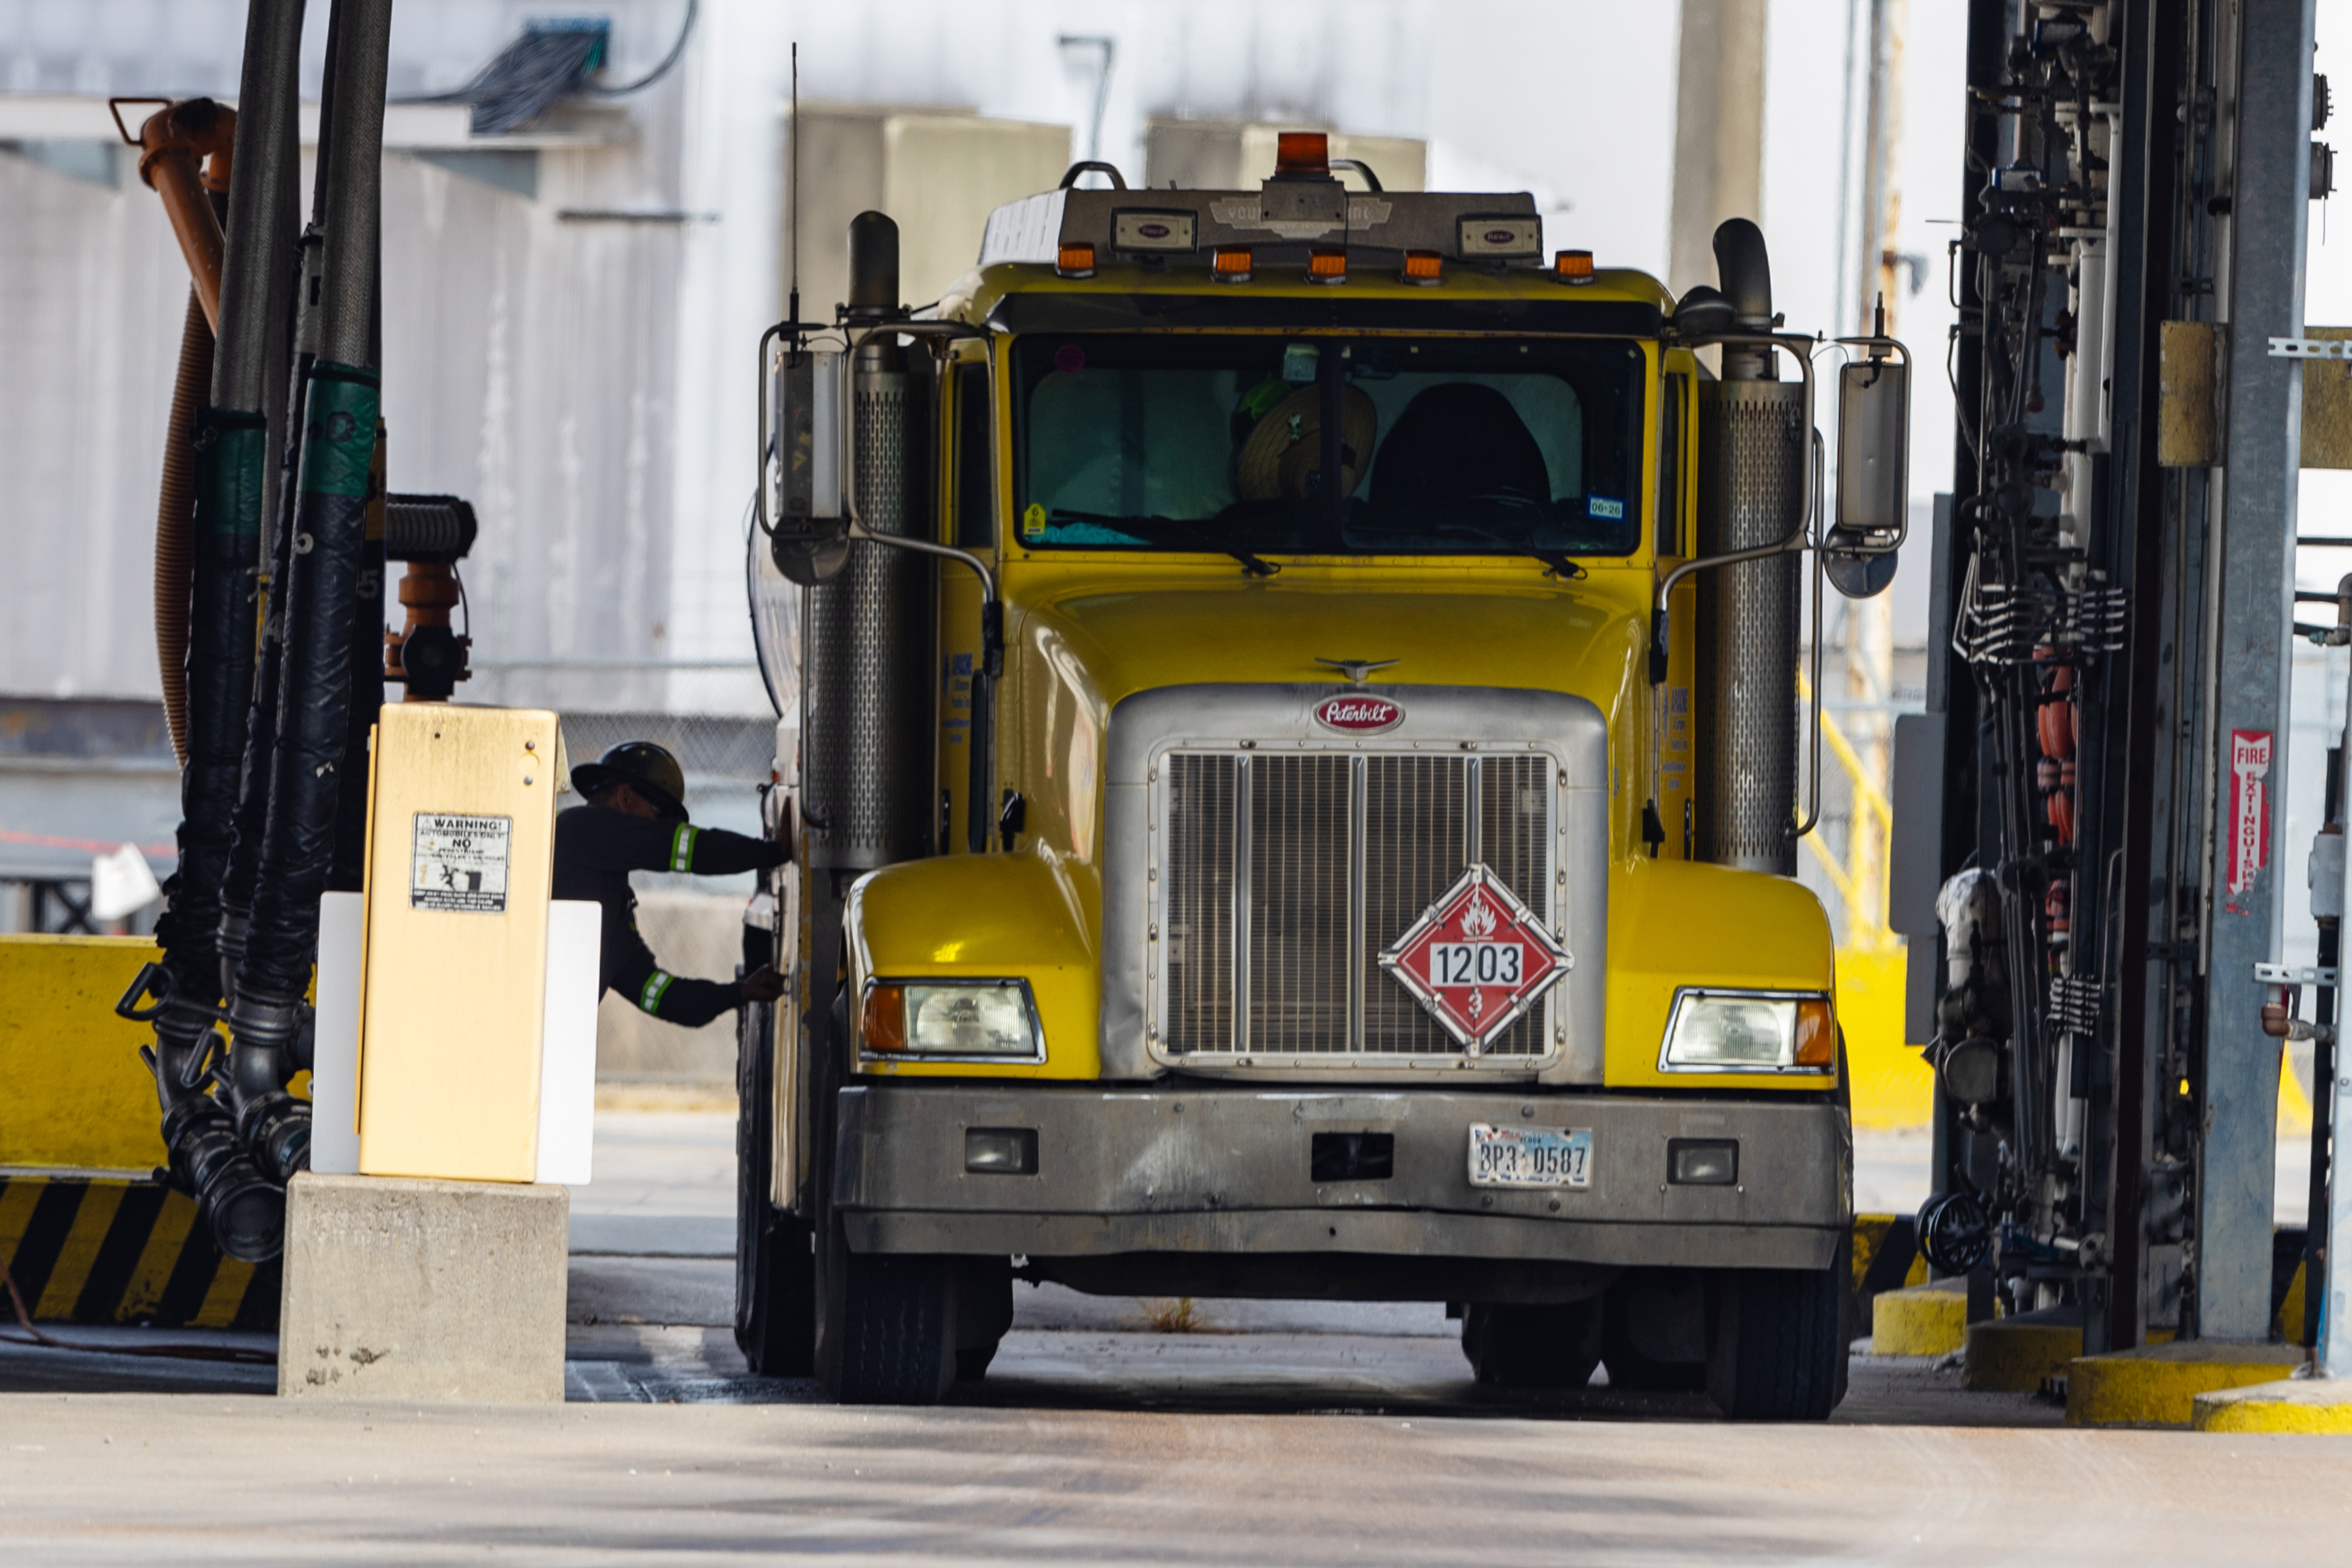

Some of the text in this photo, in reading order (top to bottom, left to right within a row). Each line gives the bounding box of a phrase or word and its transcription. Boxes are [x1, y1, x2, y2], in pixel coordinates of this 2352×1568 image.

[358, 569, 379, 599] 5
[1327, 701, 1392, 722] Peterbilt
[2237, 747, 2266, 765] FIRE
[434, 818, 502, 830] WARNING!
[2242, 771, 2256, 892] EXTINGUISH
[453, 839, 471, 847] NO
[1436, 945, 1519, 984] 1203
[1468, 990, 1483, 1018] 3
[1534, 1147, 1586, 1174] 0587
